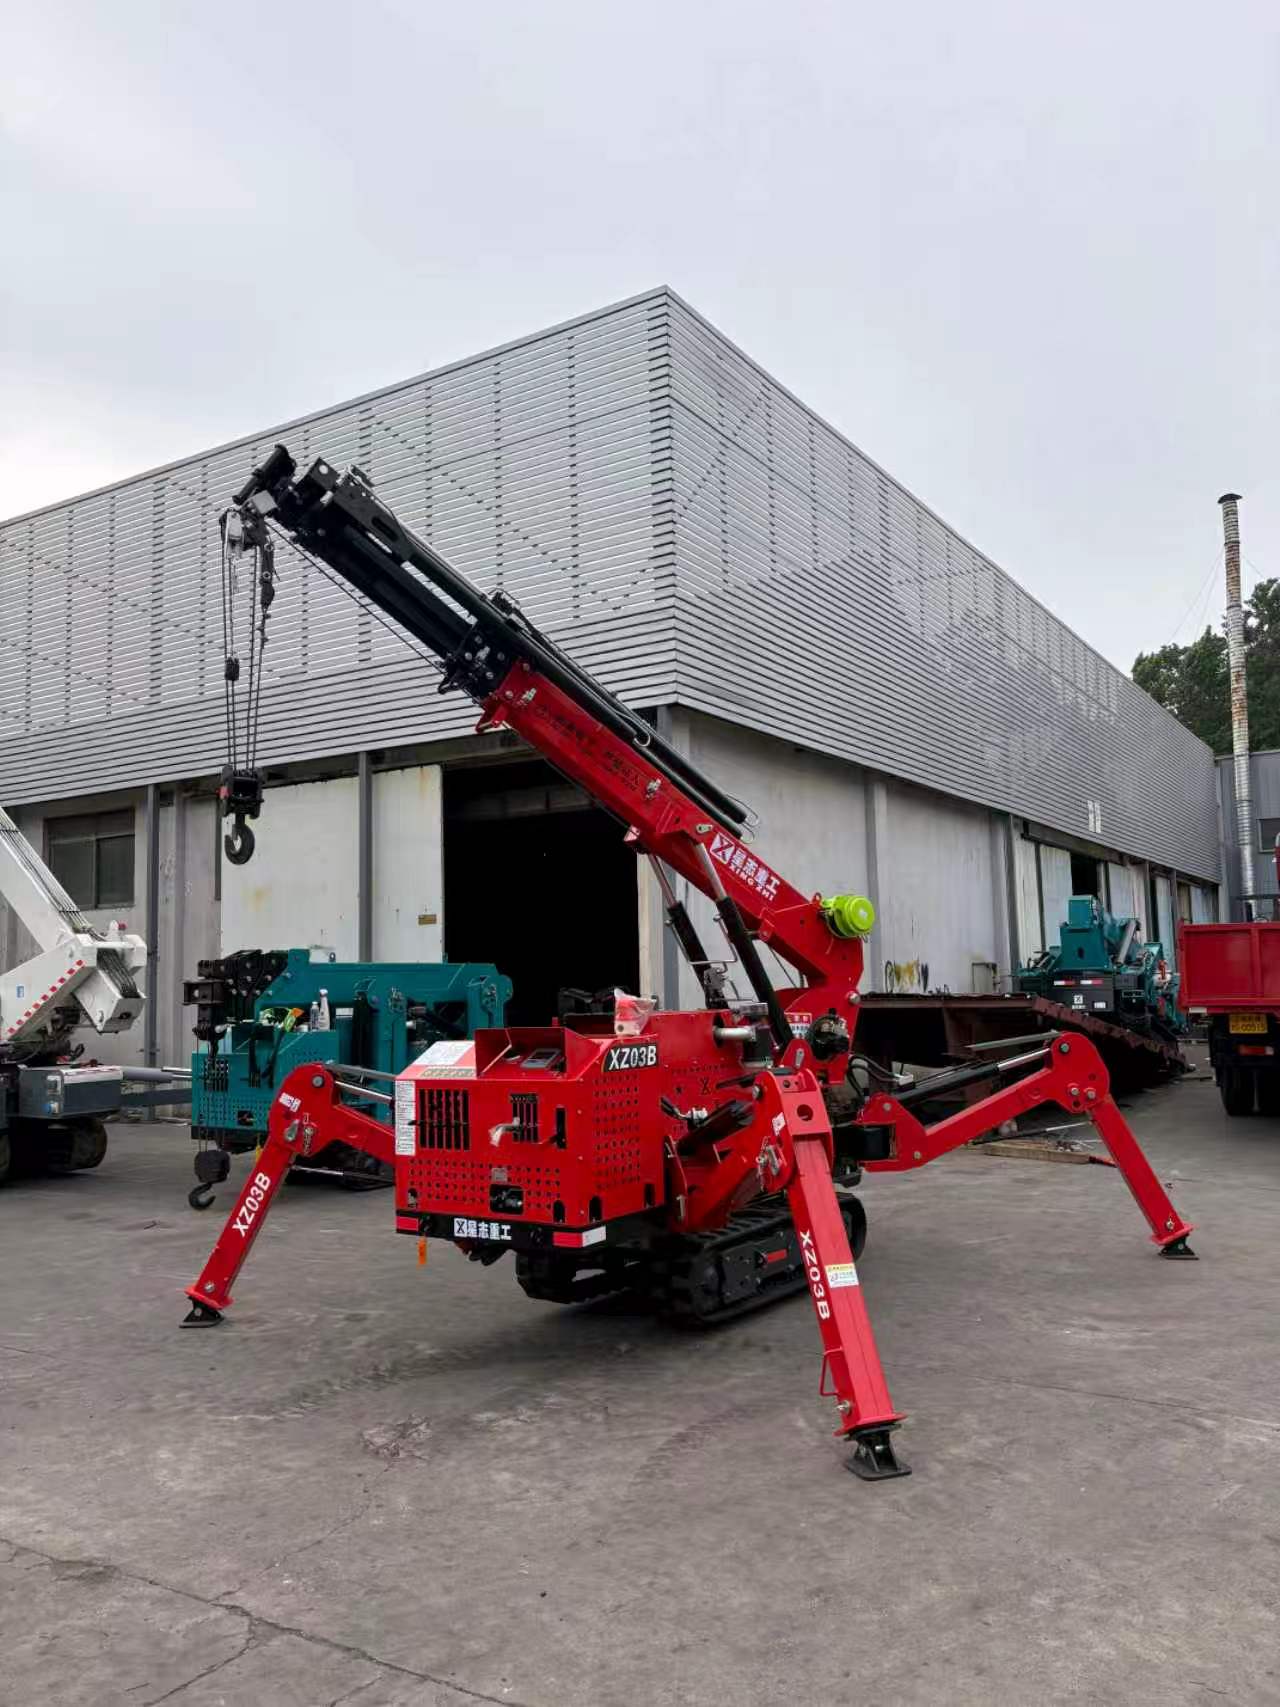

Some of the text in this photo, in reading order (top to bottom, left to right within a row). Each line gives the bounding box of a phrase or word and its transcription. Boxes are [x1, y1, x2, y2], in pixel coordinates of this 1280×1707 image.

[608, 1045, 656, 1071] XZ03B
[232, 1172, 271, 1238] XZ03B
[800, 1229, 831, 1321] XZ03B
